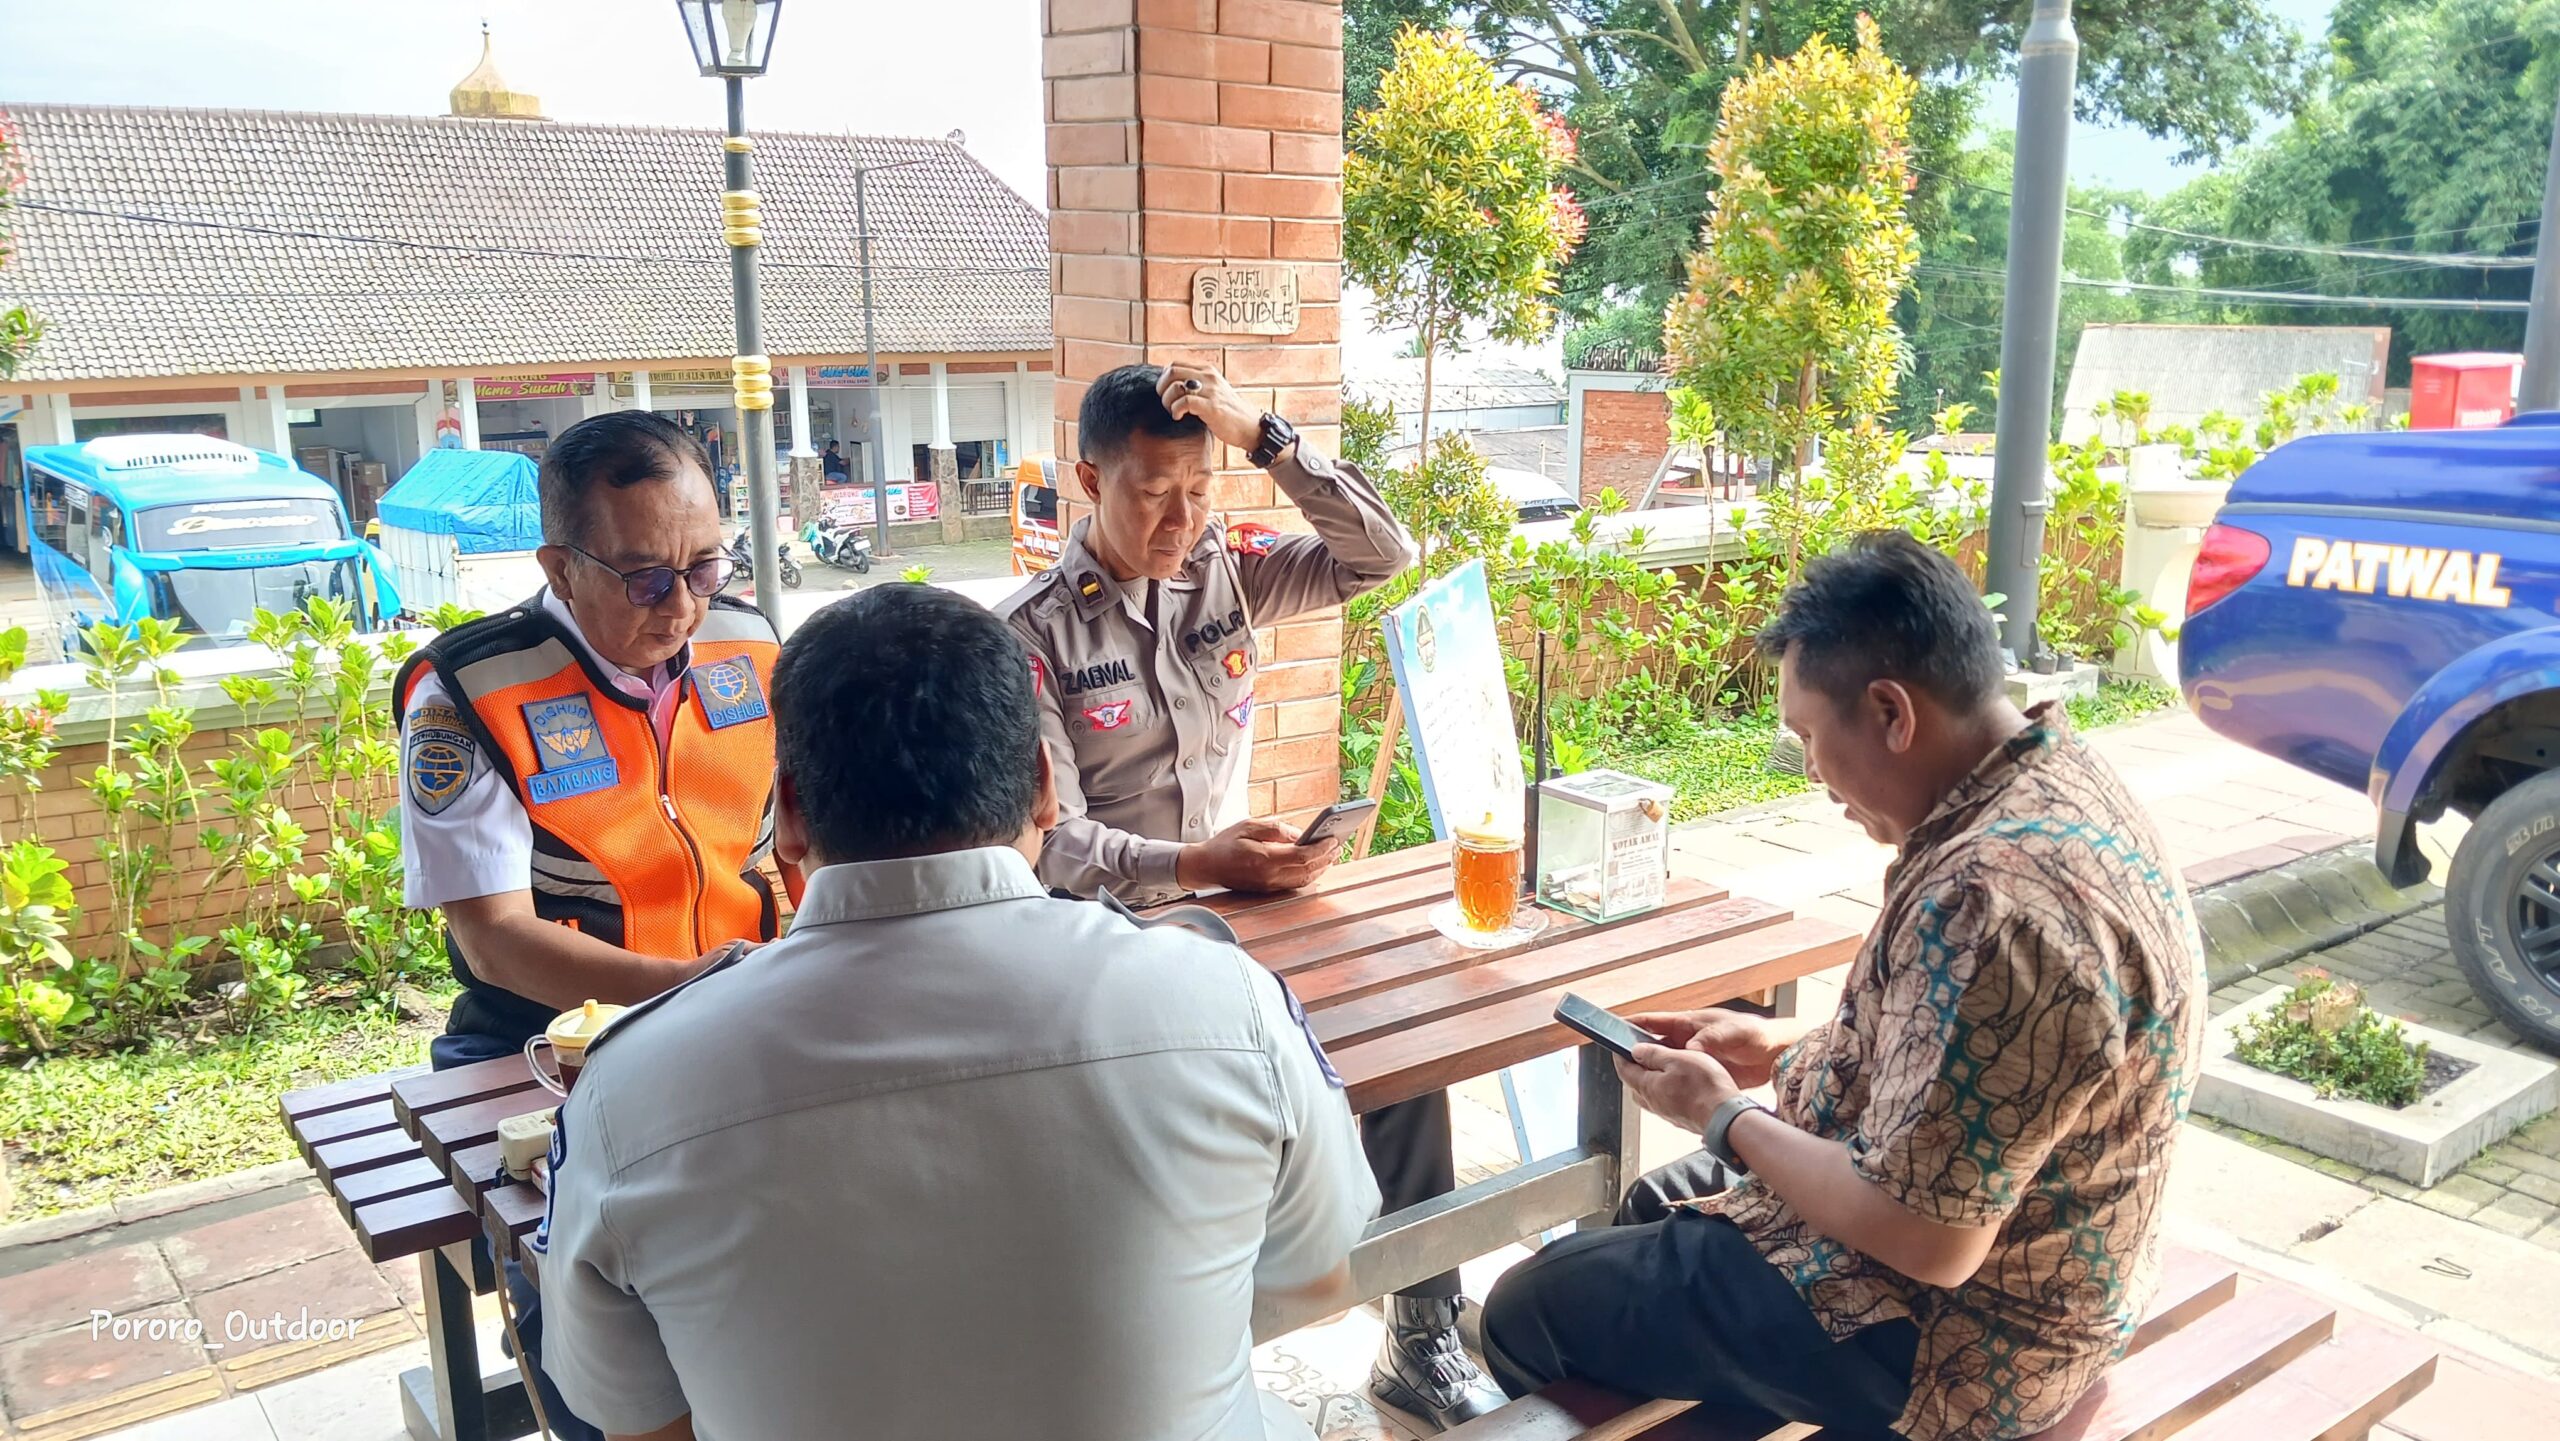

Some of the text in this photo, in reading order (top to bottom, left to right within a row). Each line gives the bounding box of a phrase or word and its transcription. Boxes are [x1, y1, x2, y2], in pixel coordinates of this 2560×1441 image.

[1226, 270, 1261, 287] WIFI
[1224, 288, 1271, 299] SEDANG
[1199, 301, 1294, 325] TROUBLE
[2286, 536, 2512, 609] PATWAL
[1061, 658, 1136, 695] ZAENAL
[533, 703, 589, 727] DISHUB
[710, 700, 765, 725] DISHUB
[413, 731, 472, 749] PERHUBUNGAN
[534, 765, 613, 797] BAMBANG
